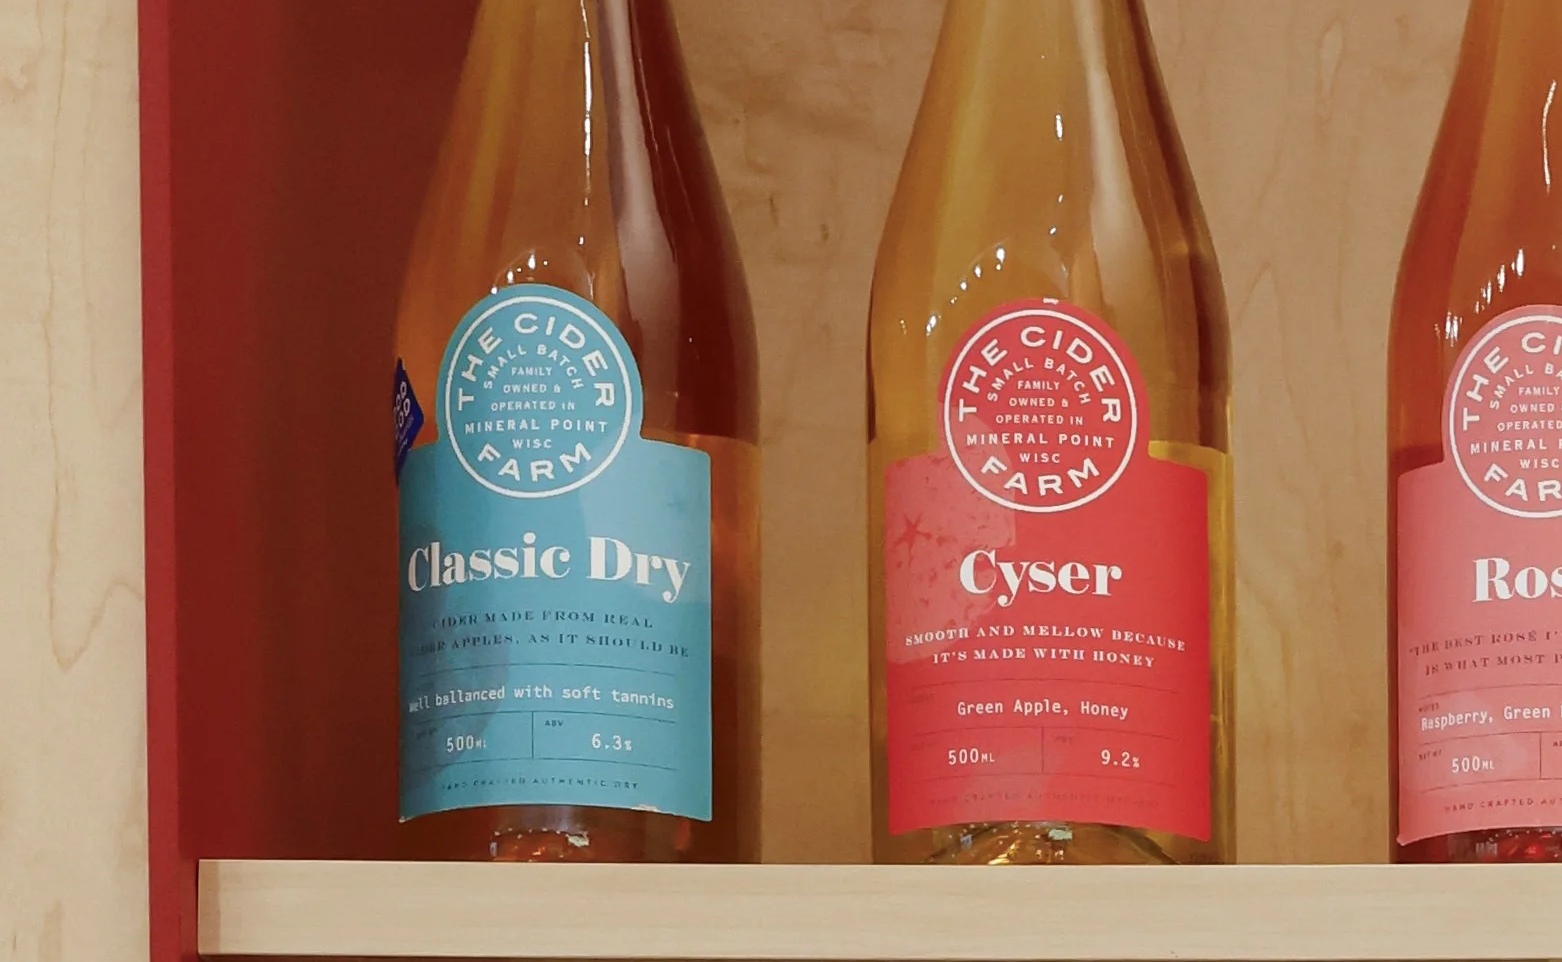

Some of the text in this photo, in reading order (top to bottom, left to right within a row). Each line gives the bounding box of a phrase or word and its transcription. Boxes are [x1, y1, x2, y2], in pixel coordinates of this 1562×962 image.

[457, 312, 615, 412] THE CIDER
[483, 344, 584, 390] SMALL BATCH
[958, 326, 1122, 423] THE CIDER
[987, 357, 1091, 404] SMALL BATCH
[1463, 346, 1509, 431] THE
[1489, 364, 1534, 410] SMALL
[465, 419, 608, 433] MINERAL POINT
[966, 433, 1115, 448] MINERAL POINT
[477, 442, 592, 482] FARM
[1470, 439, 1548, 454] MINERAL
[981, 456, 1100, 496] FARM
[408, 532, 691, 604] Classic Dry
[959, 549, 1122, 607] Cyser
[905, 625, 1186, 651] SMOOTH AND MELLOW BECAUSE
[933, 648, 1155, 667] IT'S MADE WITH HONEY
[514, 685, 552, 699] with
[562, 686, 601, 700] soft
[612, 690, 675, 709] tannins
[957, 698, 1128, 720] Green Apple, Honey
[1421, 708, 1494, 731] Raspberry,
[1504, 706, 1550, 720] Green
[592, 734, 632, 751] 6.3%
[1100, 750, 1140, 768] 9.2%
